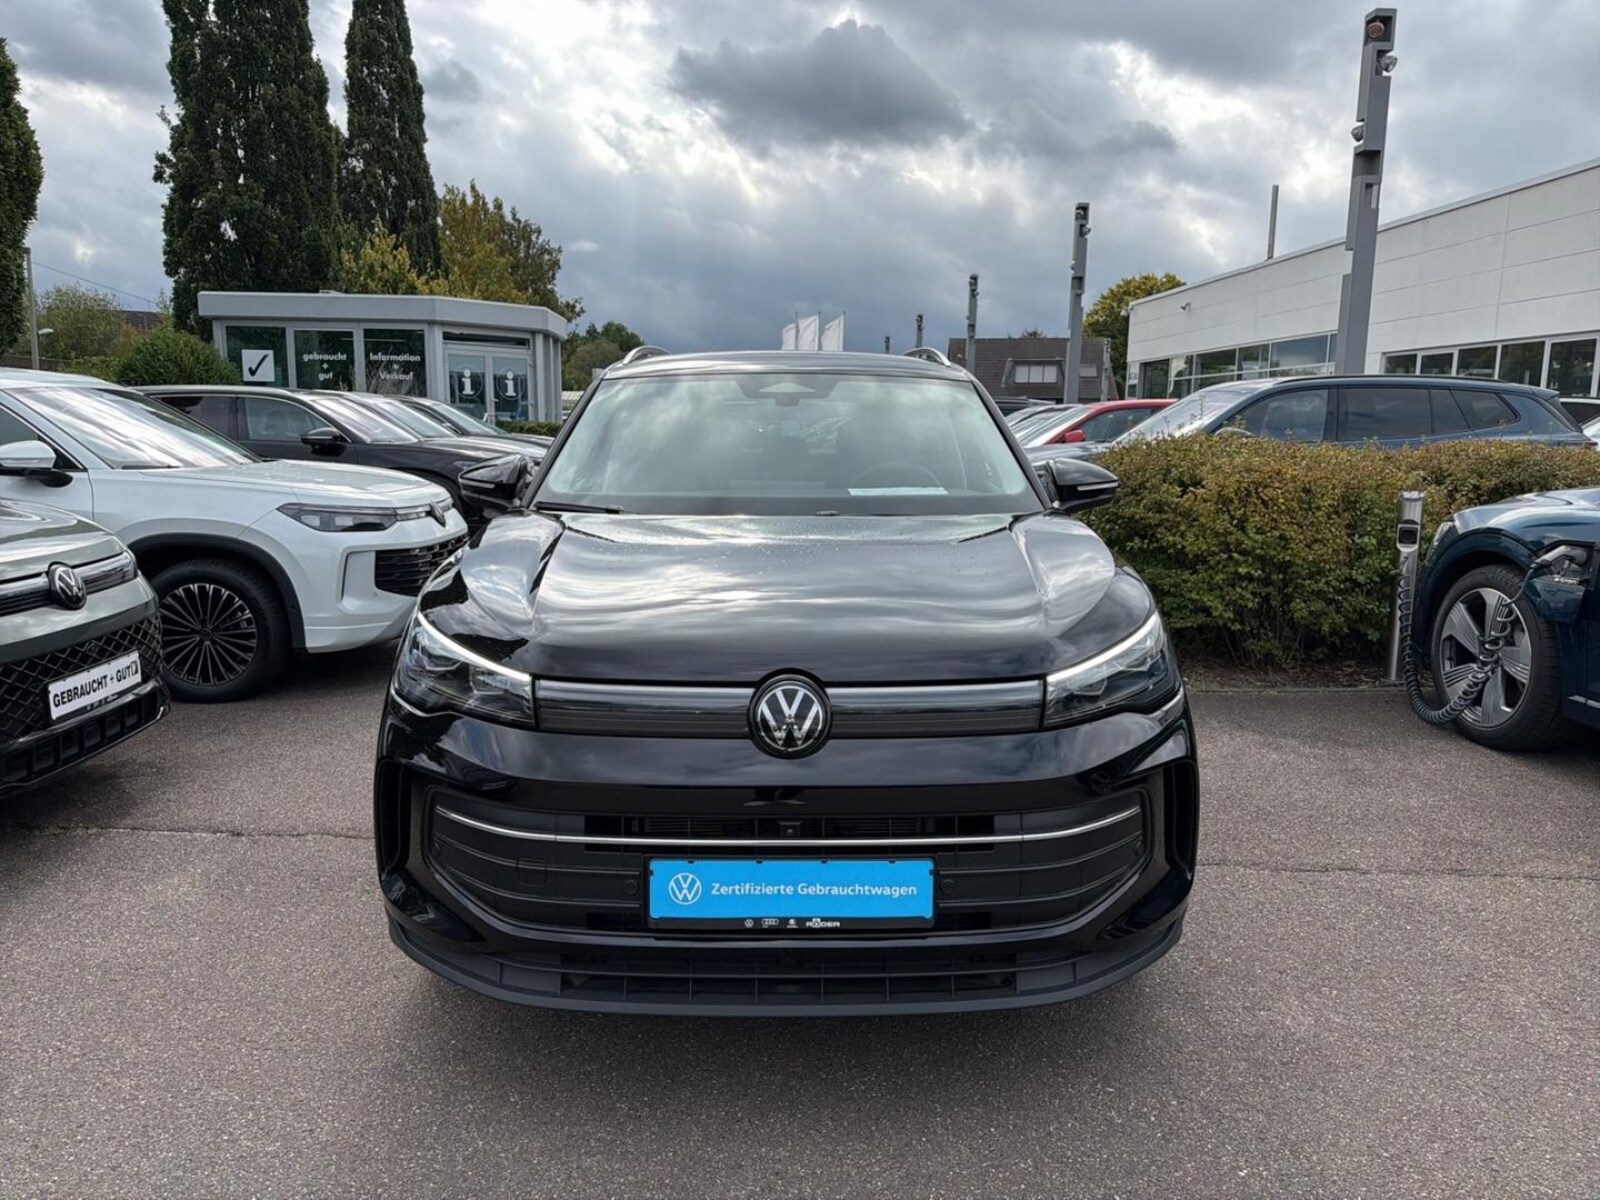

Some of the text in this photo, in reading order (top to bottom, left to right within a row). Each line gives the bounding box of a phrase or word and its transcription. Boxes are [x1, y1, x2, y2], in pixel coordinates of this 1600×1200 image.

[302, 351, 347, 362] gebraucht
[369, 352, 421, 362] Information
[318, 370, 334, 381] gut
[379, 371, 414, 381] Verkauf
[52, 675, 108, 708] GEBRAUCHT
[115, 665, 132, 683] GUT
[710, 883, 917, 898] Zertifizierte Gebrauchtwagen
